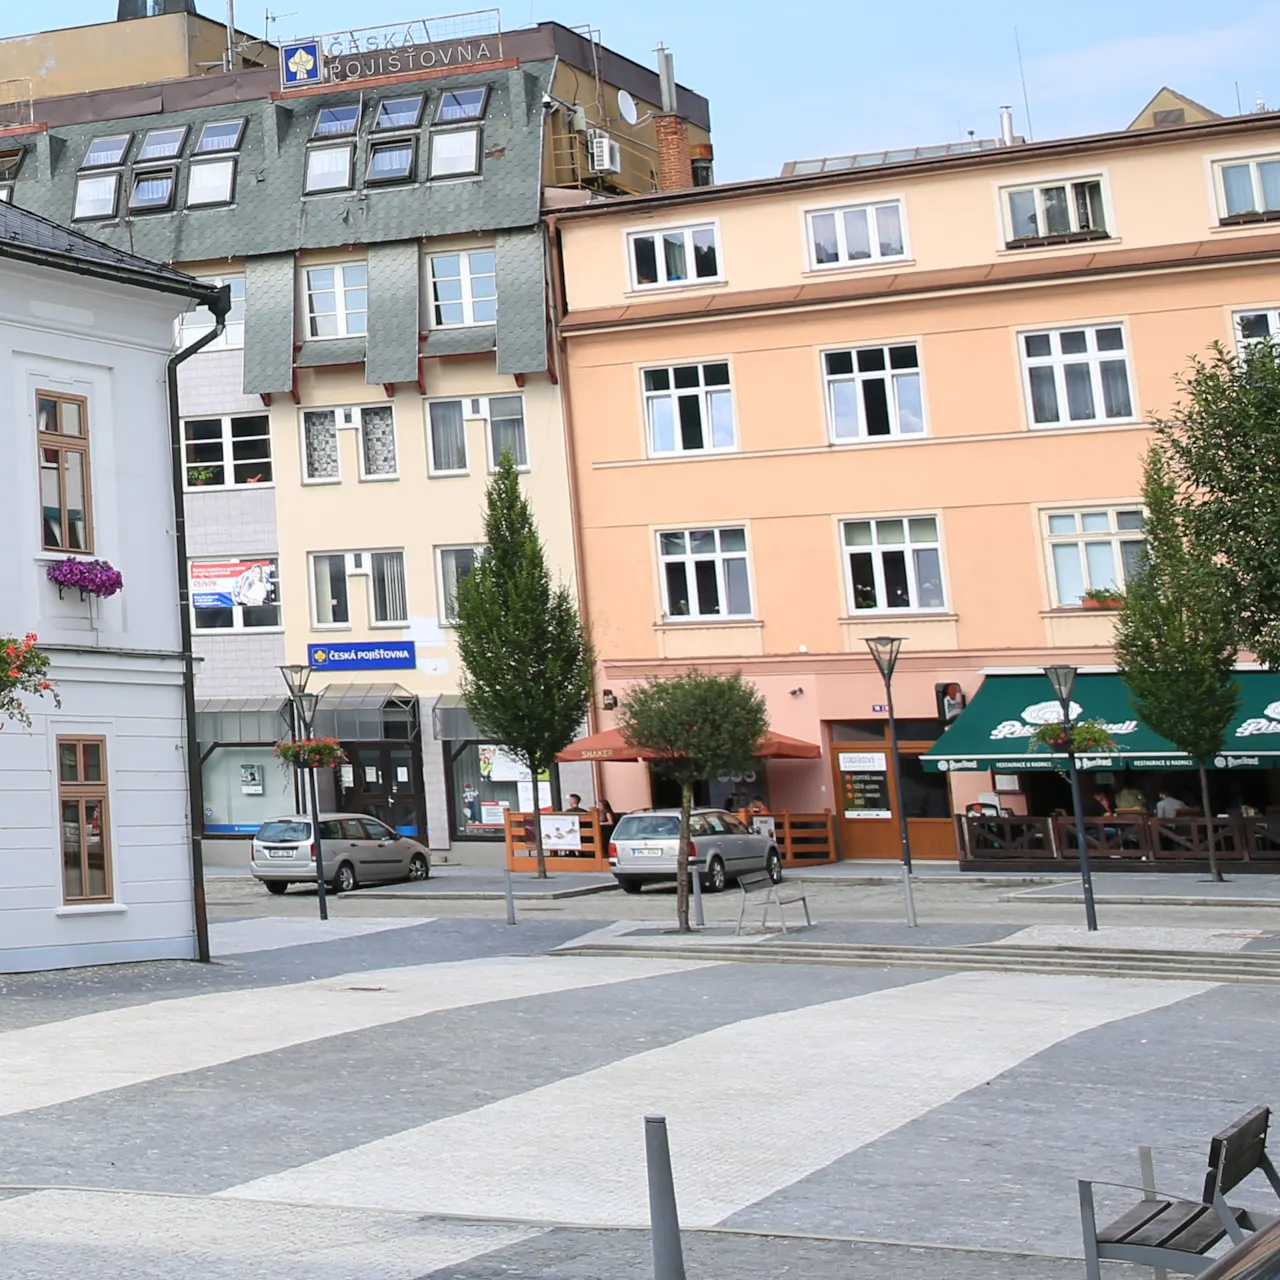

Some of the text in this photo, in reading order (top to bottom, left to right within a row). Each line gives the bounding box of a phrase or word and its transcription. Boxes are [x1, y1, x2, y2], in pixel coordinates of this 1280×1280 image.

[330, 25, 416, 56] ČESKÁ
[329, 42, 491, 81] POJIŠŤOVNA
[329, 649, 409, 660] ČESKÁ POJIŠŤOVNA
[581, 749, 613, 759] SHAKER
